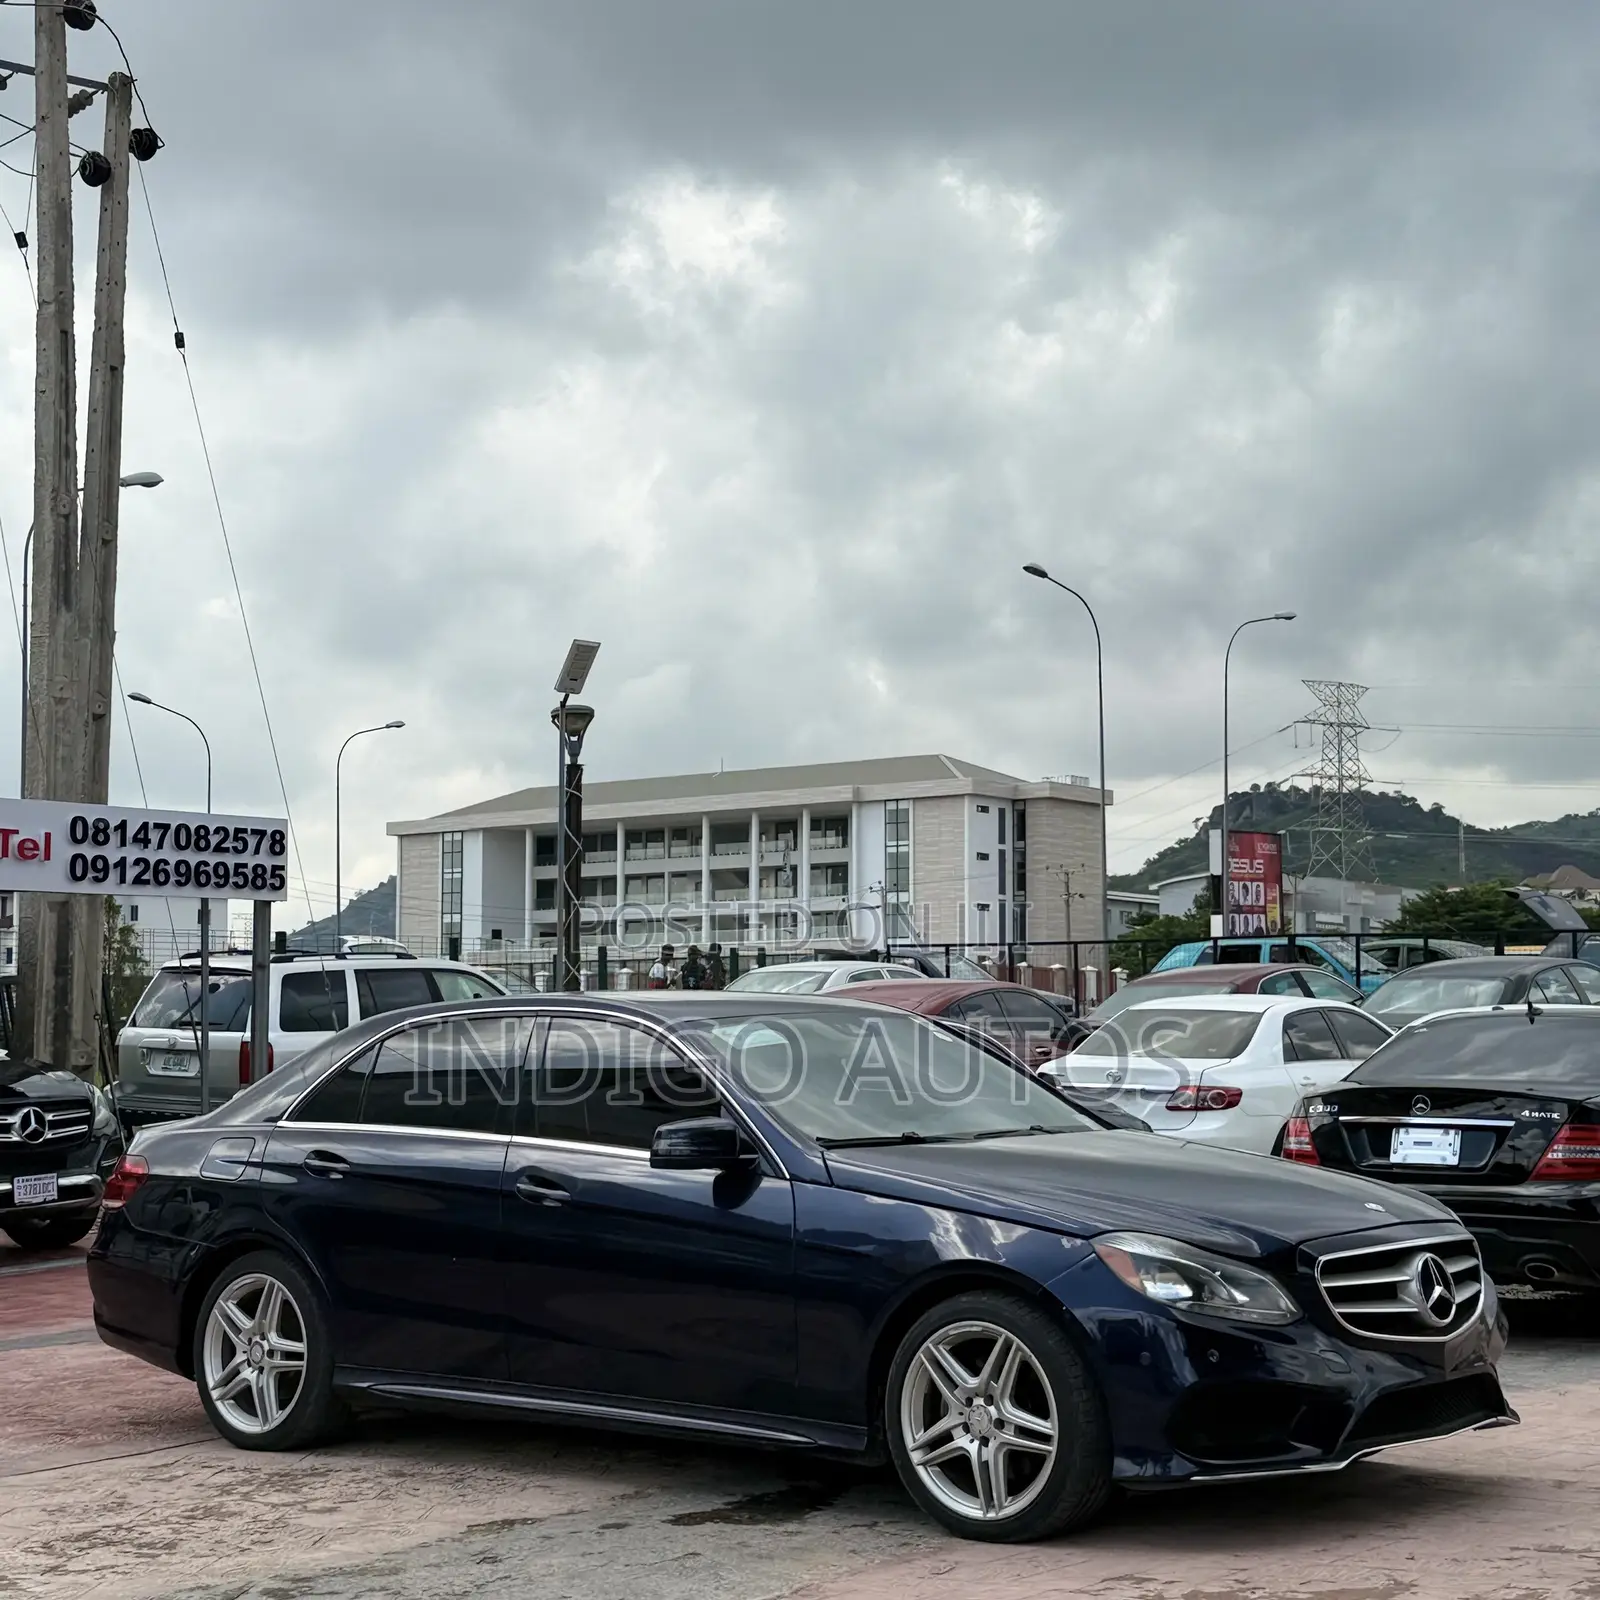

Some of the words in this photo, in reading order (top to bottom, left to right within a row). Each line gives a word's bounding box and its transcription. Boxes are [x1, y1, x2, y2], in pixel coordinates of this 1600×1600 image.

[0, 828, 52, 861] Tel
[69, 815, 286, 856] 08147082578
[69, 853, 286, 891] 09126969585
